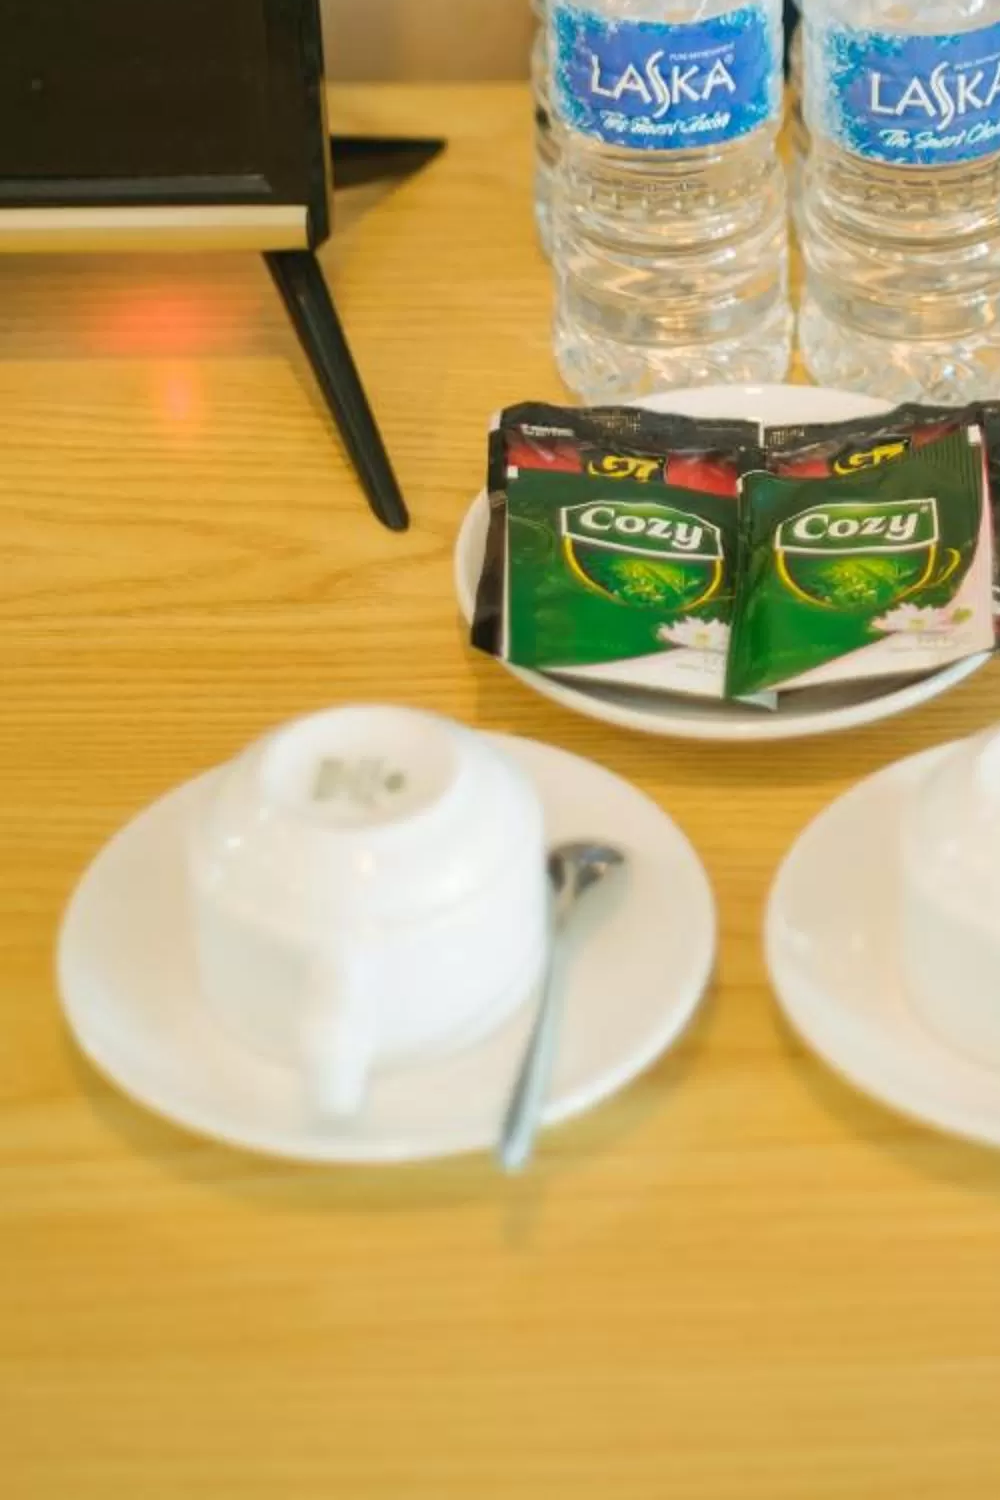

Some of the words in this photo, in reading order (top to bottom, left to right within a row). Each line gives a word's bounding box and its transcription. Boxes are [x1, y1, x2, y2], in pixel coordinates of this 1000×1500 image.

[590, 49, 737, 119] LASKA
[579, 505, 703, 551] Cozy
[792, 511, 919, 541] Cozy
